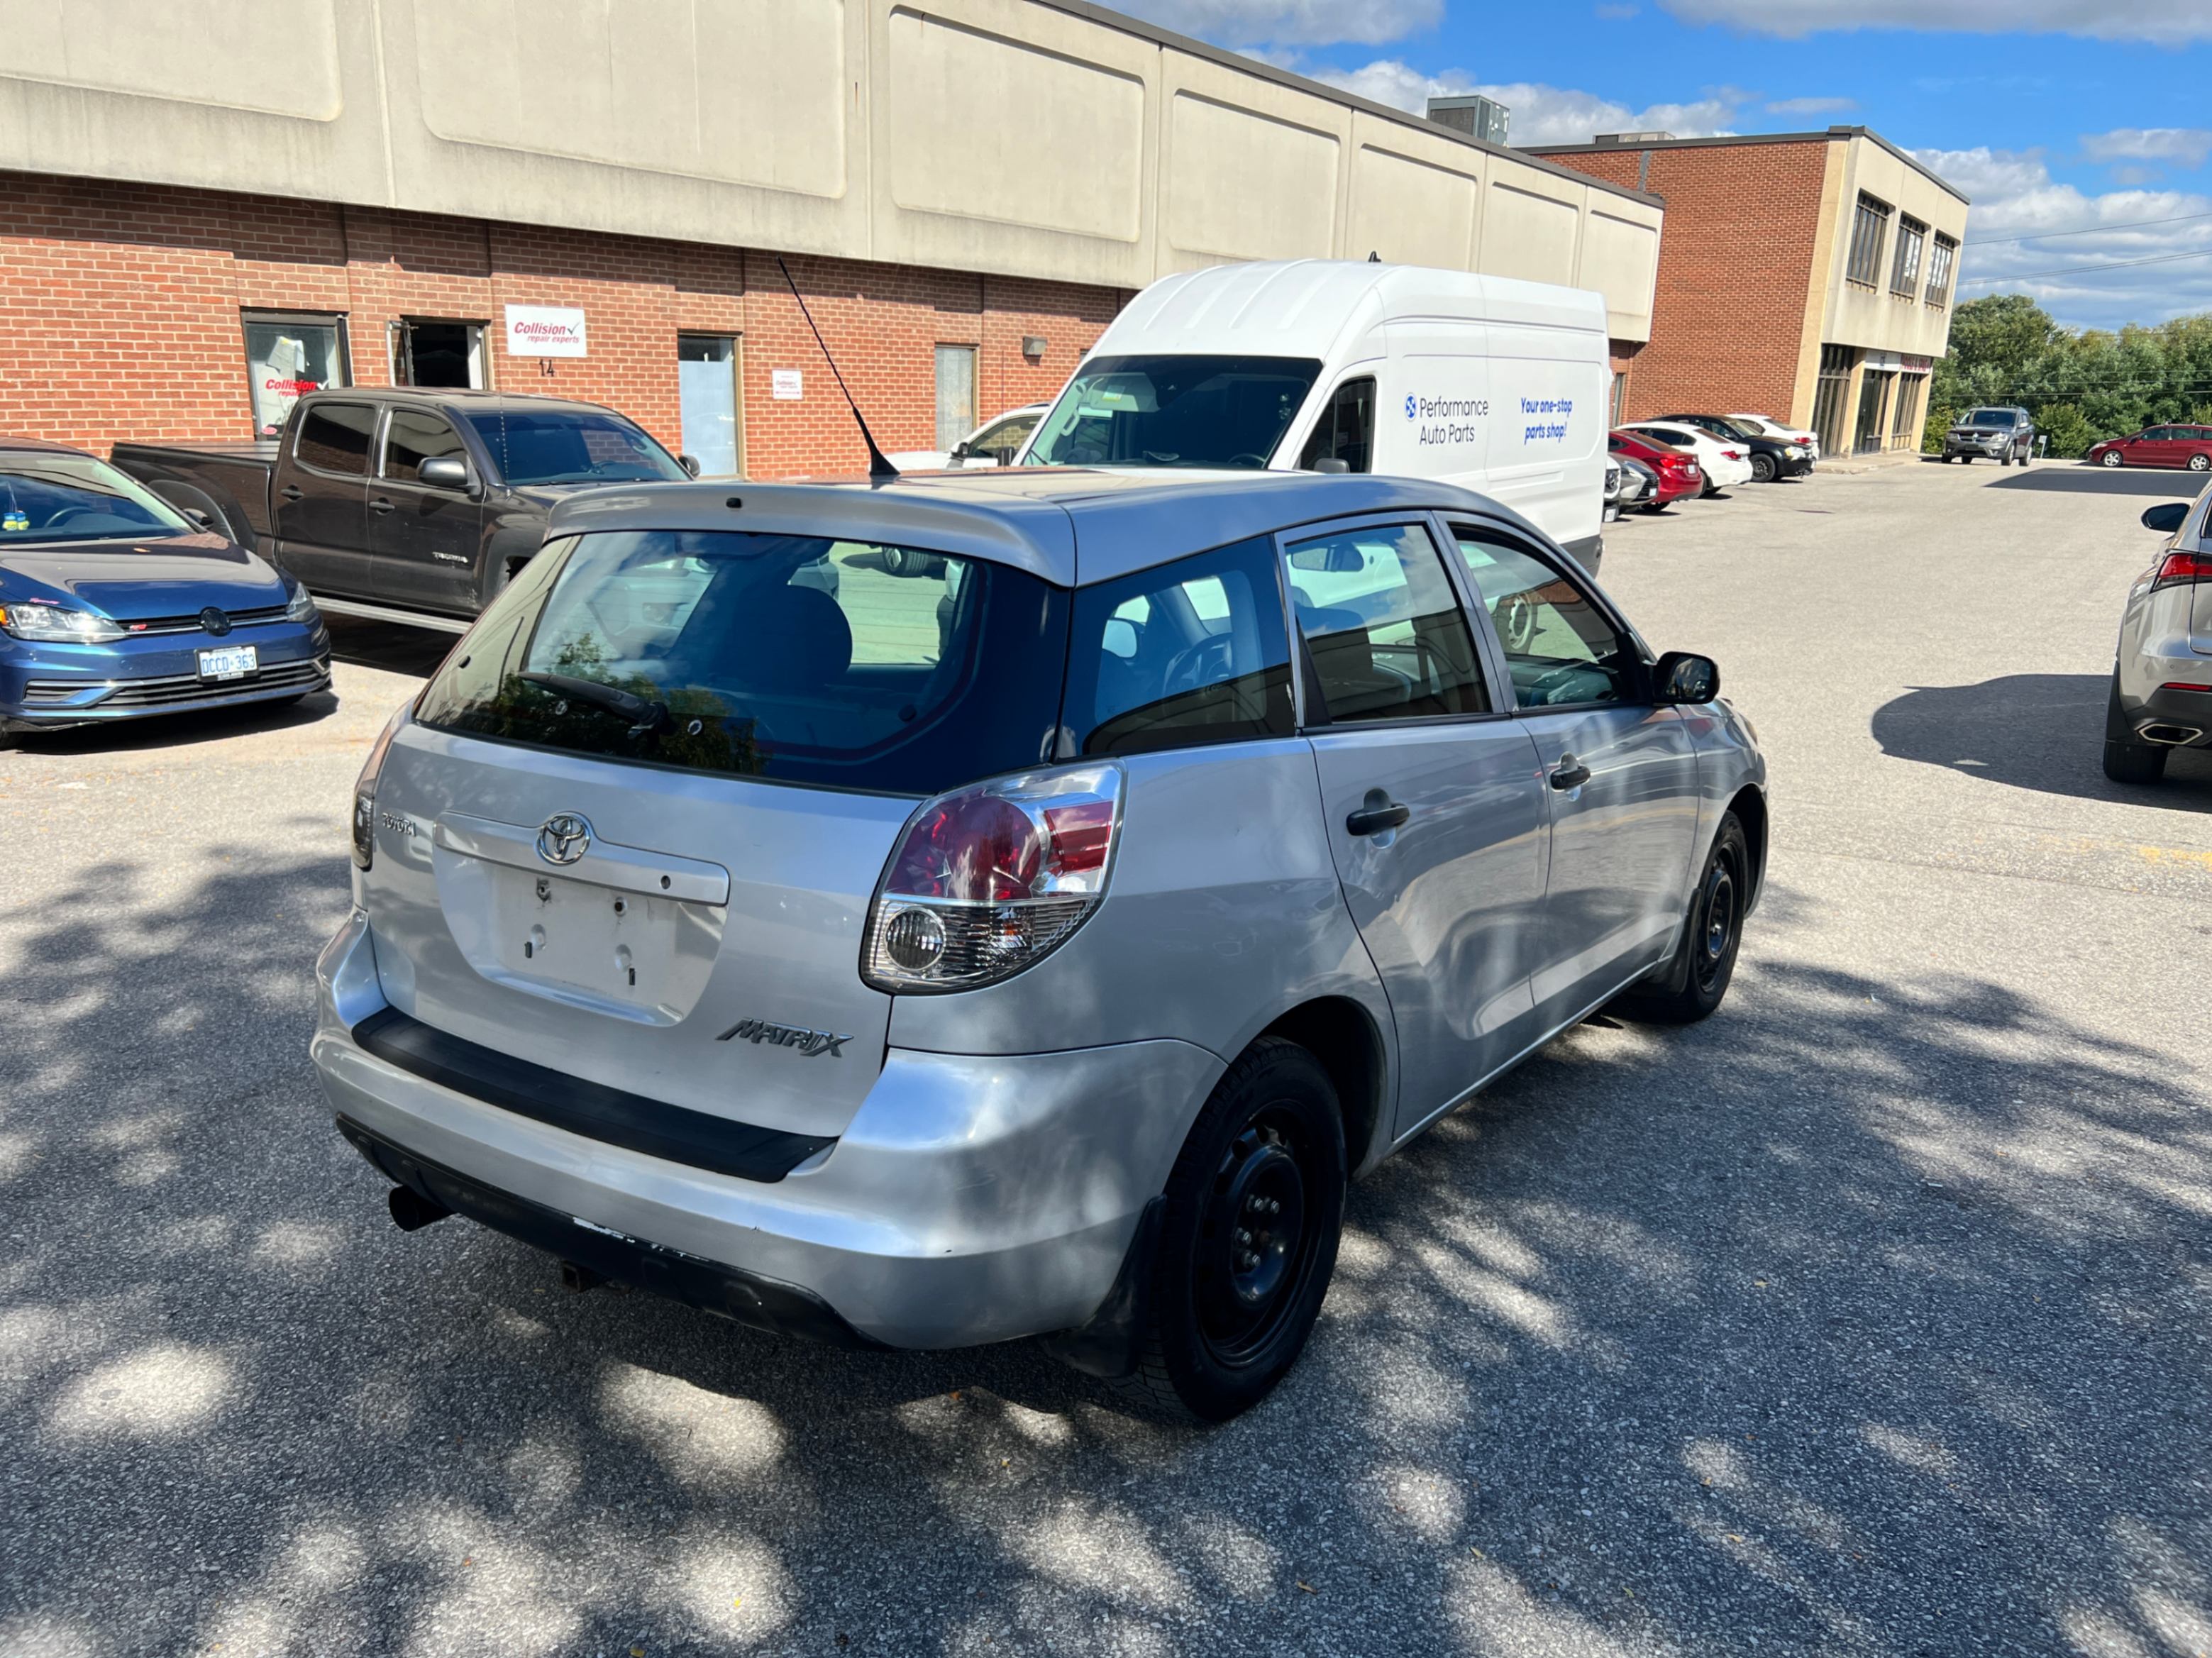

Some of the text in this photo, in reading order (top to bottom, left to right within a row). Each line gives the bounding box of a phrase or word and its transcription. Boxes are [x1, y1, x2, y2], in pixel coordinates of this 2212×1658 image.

[514, 322, 566, 335] Collision
[552, 336, 580, 344] experts
[539, 359, 555, 377] 14
[265, 379, 316, 390] Collision
[1420, 395, 1488, 418] Performance
[1521, 397, 1572, 418] Your one-stop
[1420, 424, 1475, 445] Auto Parts
[1524, 421, 1567, 446] parts shop!
[235, 653, 255, 670] 363
[382, 812, 416, 837] TOYOTA
[715, 1017, 854, 1058] MATRIX
